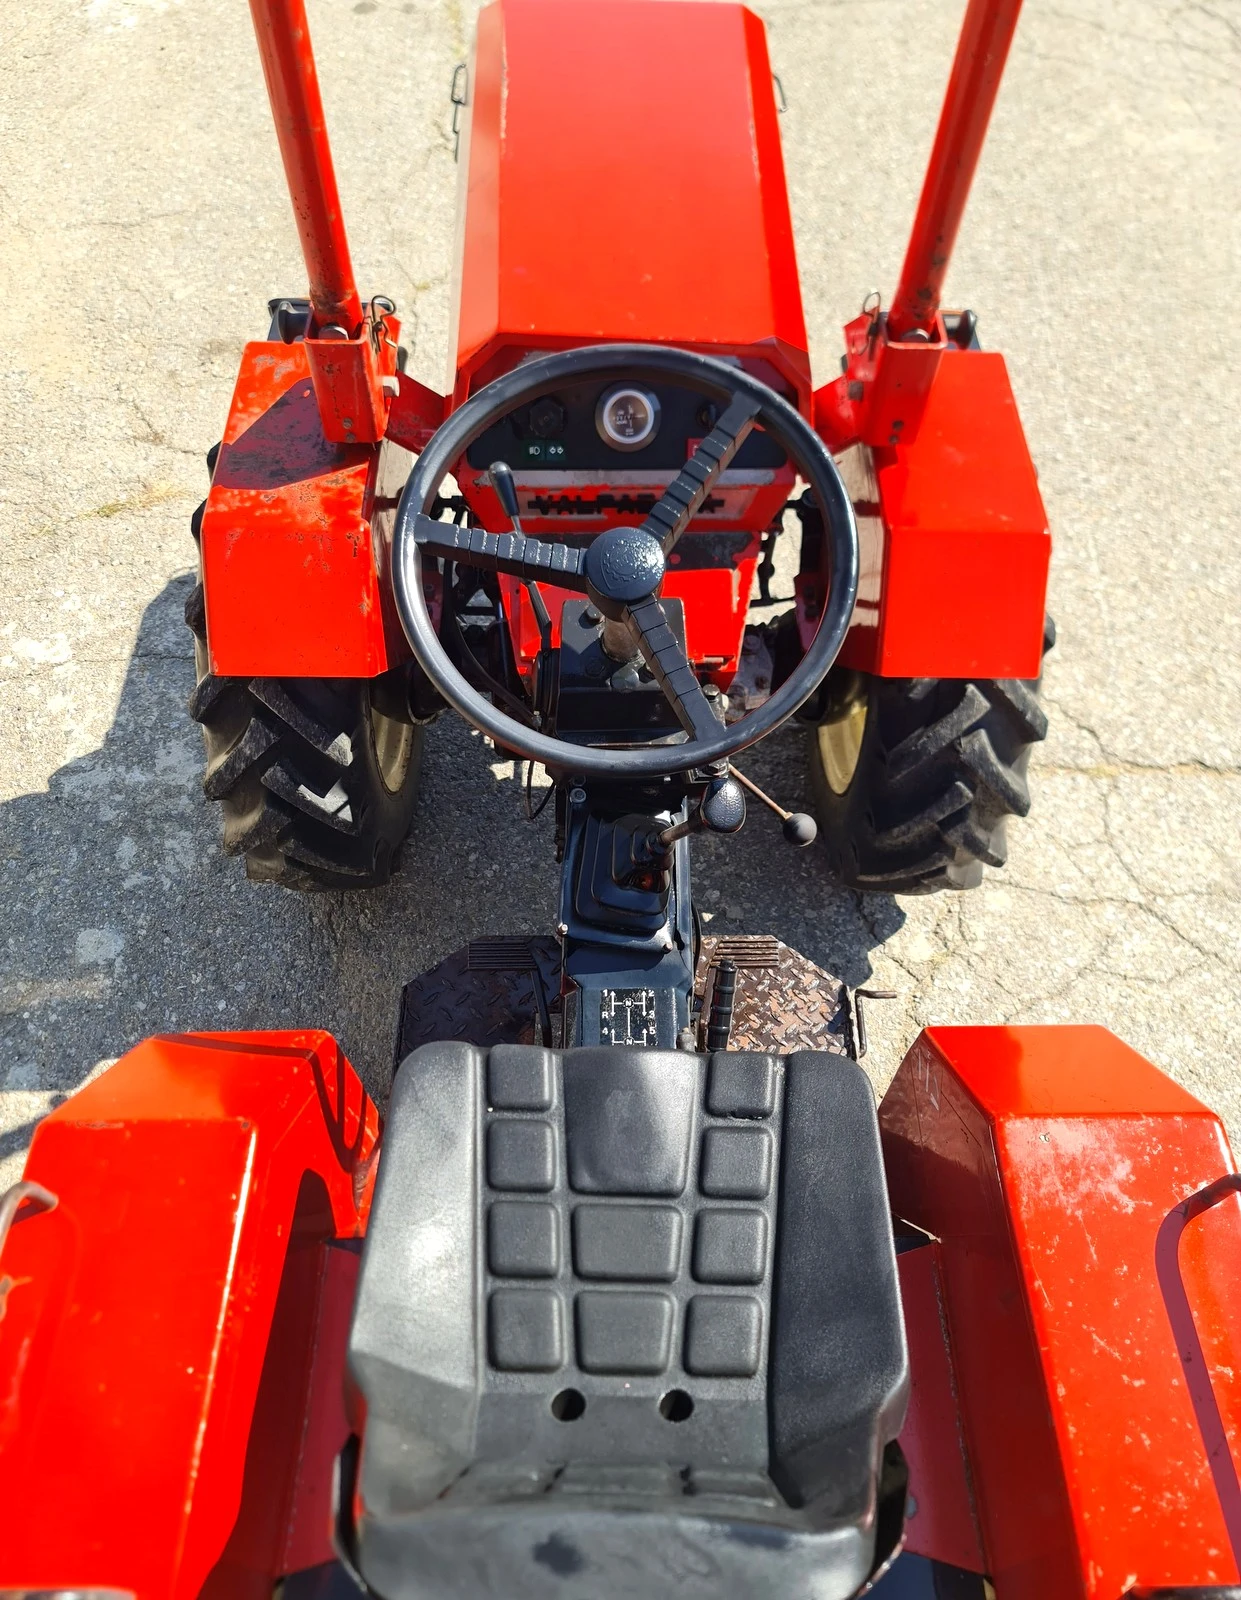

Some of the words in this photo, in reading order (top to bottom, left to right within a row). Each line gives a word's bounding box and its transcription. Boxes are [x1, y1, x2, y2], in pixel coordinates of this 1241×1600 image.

[602, 988, 608, 997] 1
[648, 989, 655, 997] 2
[601, 1011, 609, 1019] R
[648, 1010, 655, 1019] 3
[601, 1027, 609, 1036] 4
[649, 1026, 656, 1035] 5
